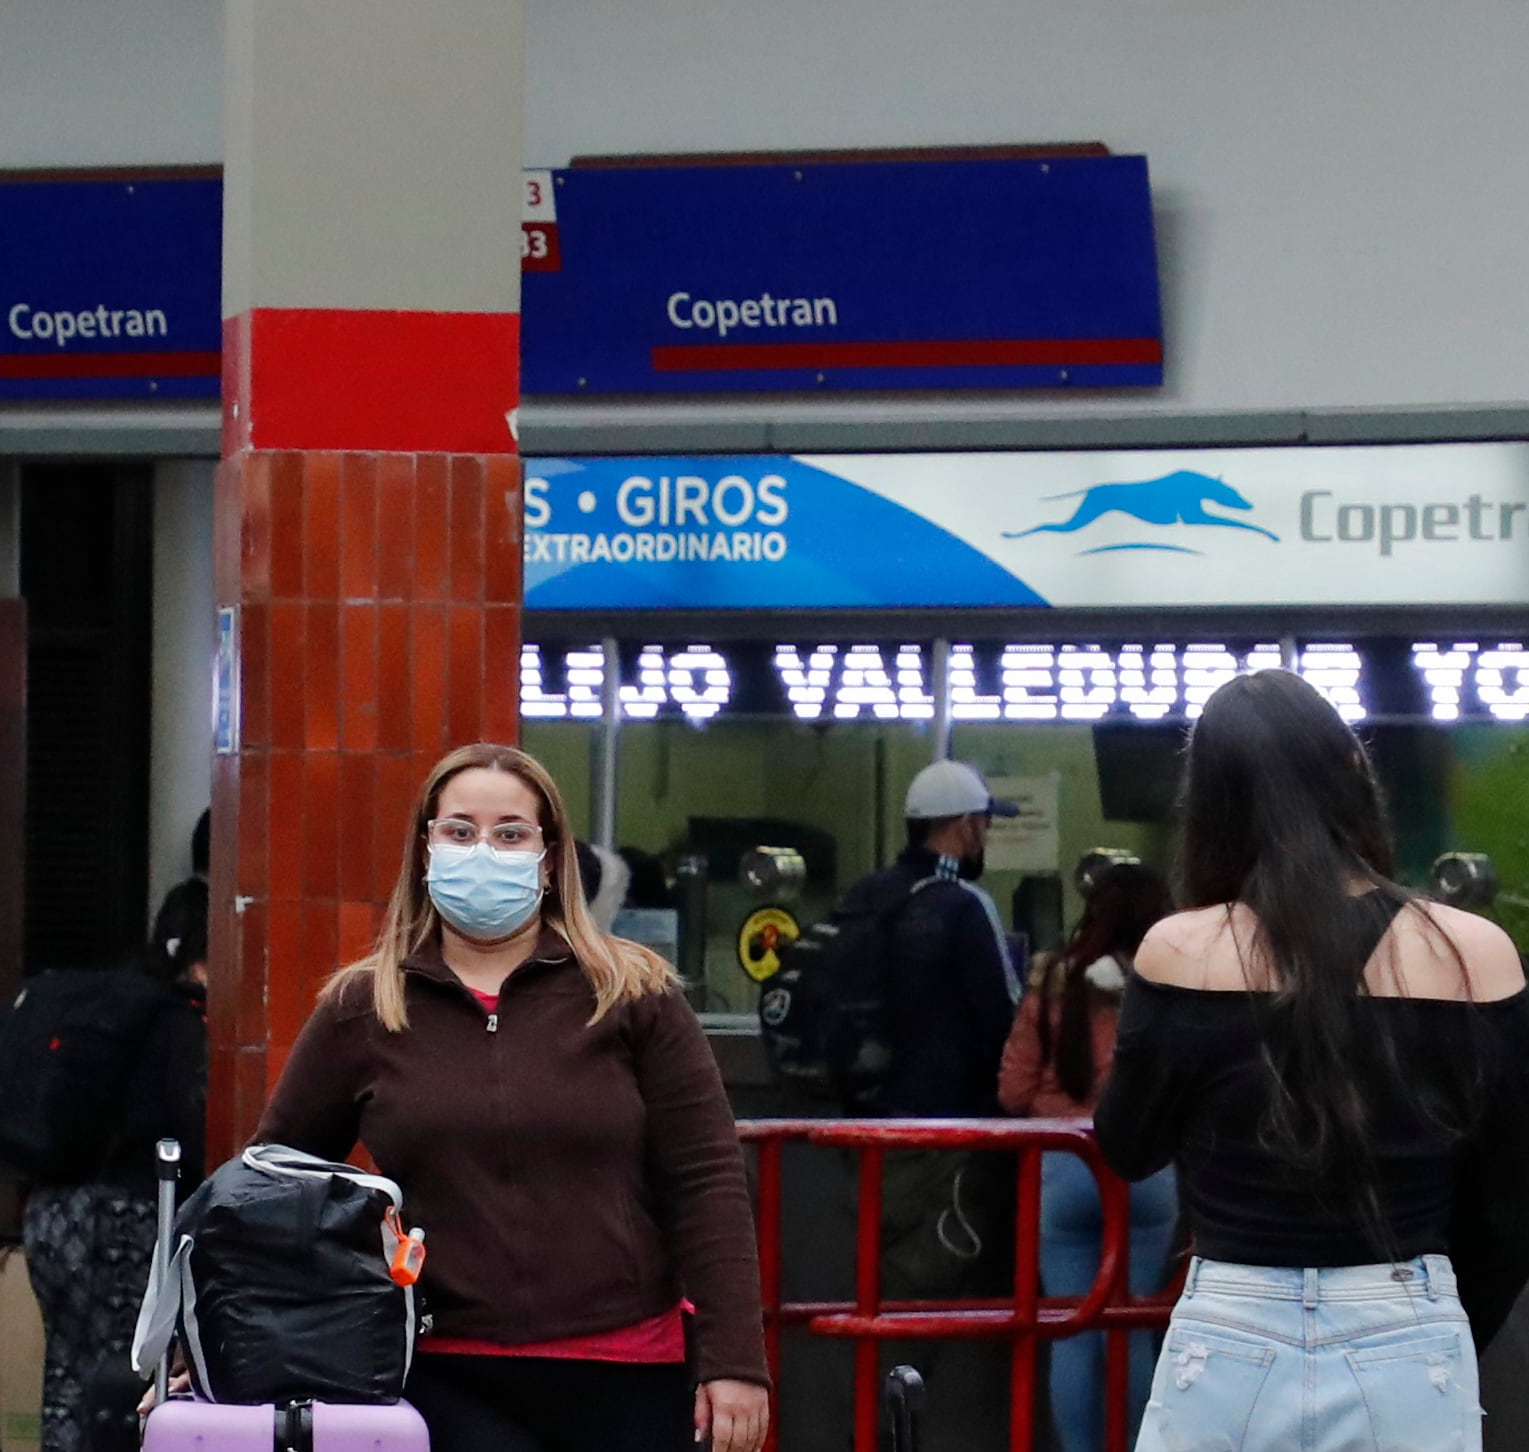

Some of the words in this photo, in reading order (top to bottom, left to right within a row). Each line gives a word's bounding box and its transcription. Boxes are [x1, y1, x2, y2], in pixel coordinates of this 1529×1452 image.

[527, 181, 542, 206] 3
[8, 303, 168, 346] Copetran
[667, 292, 838, 335] Copetran
[617, 475, 789, 527] GIROS
